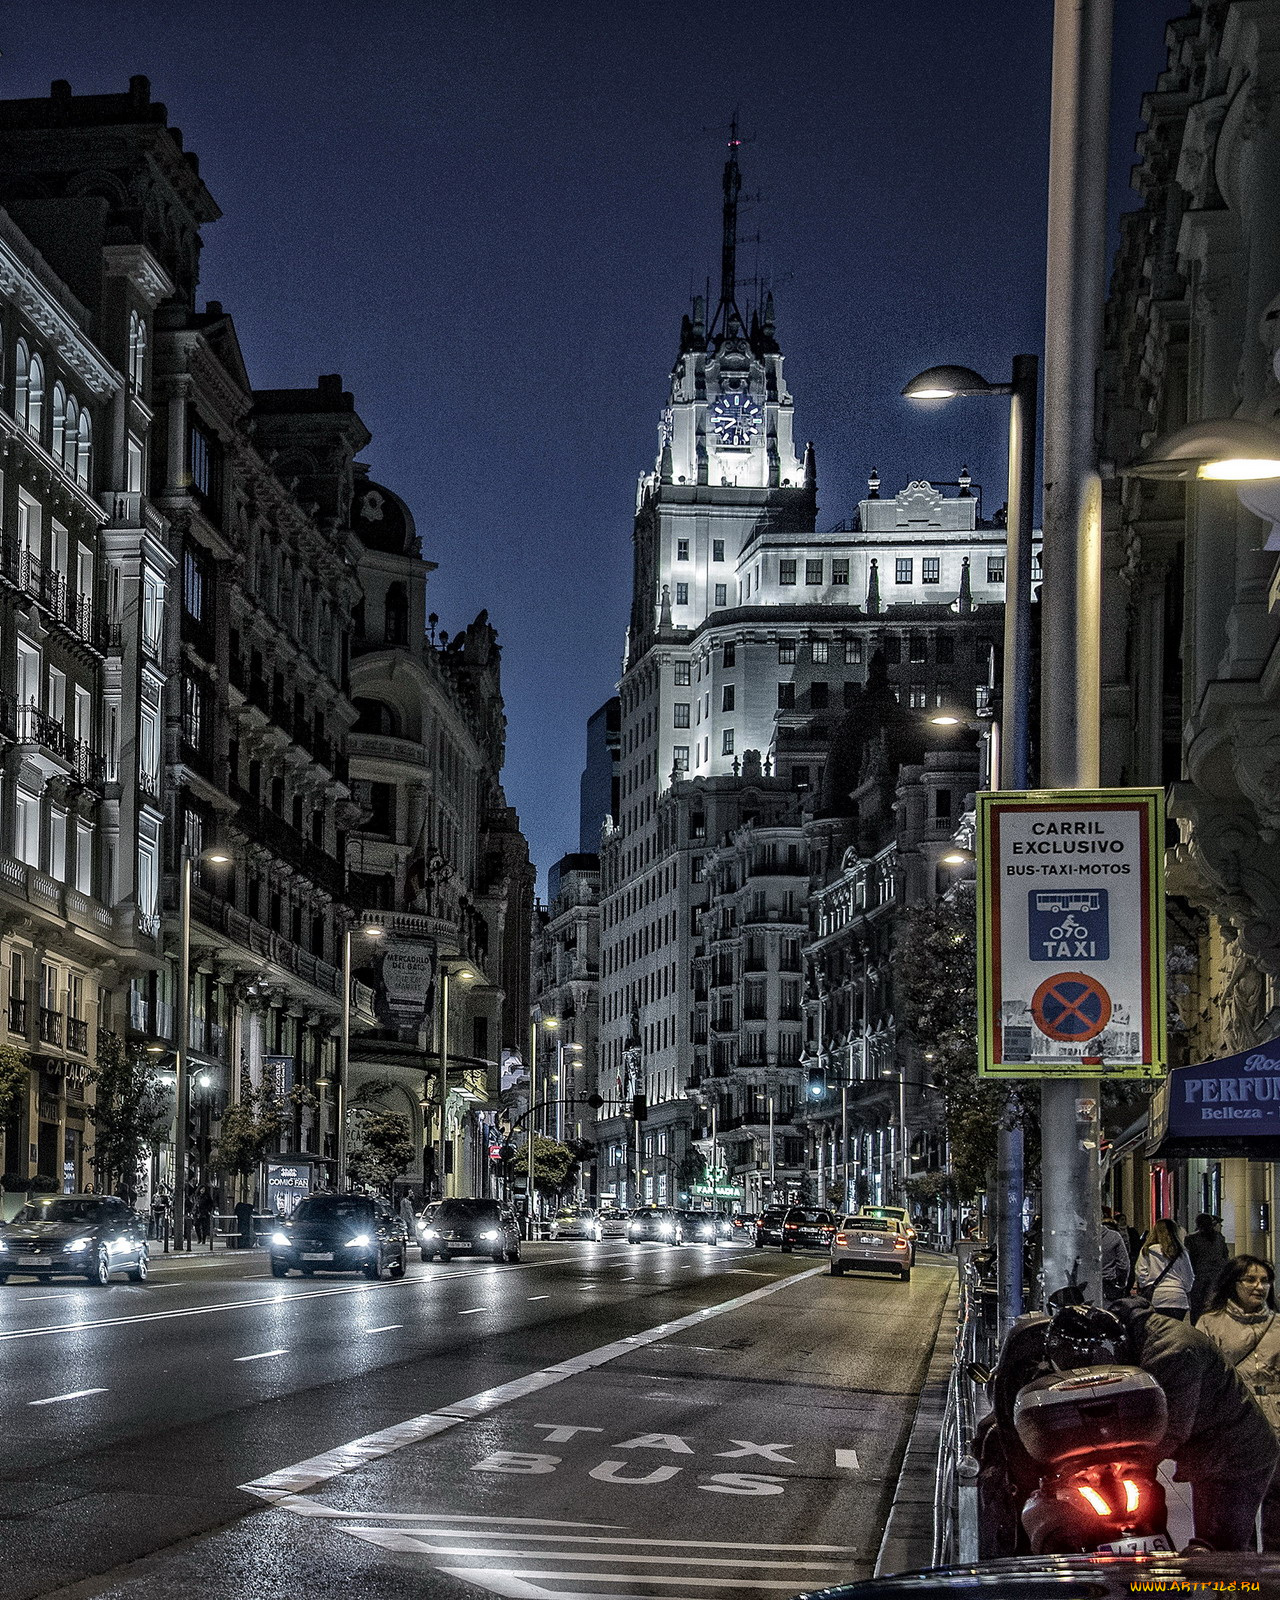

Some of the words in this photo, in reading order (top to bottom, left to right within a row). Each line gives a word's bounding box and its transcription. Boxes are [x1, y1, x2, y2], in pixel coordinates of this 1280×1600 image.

[1032, 821, 1105, 836] CARRIL
[1012, 840, 1124, 855] EXCLUSIVO
[1006, 863, 1131, 876] BUS-TAXI-MOTOS
[1043, 941, 1096, 958] TAXI
[1201, 1107, 1262, 1120] Belleza
[269, 1178, 293, 1186] COMIC
[294, 1178, 308, 1187] FAN
[533, 1423, 859, 1468] TAXI
[469, 1451, 790, 1495] BUS
